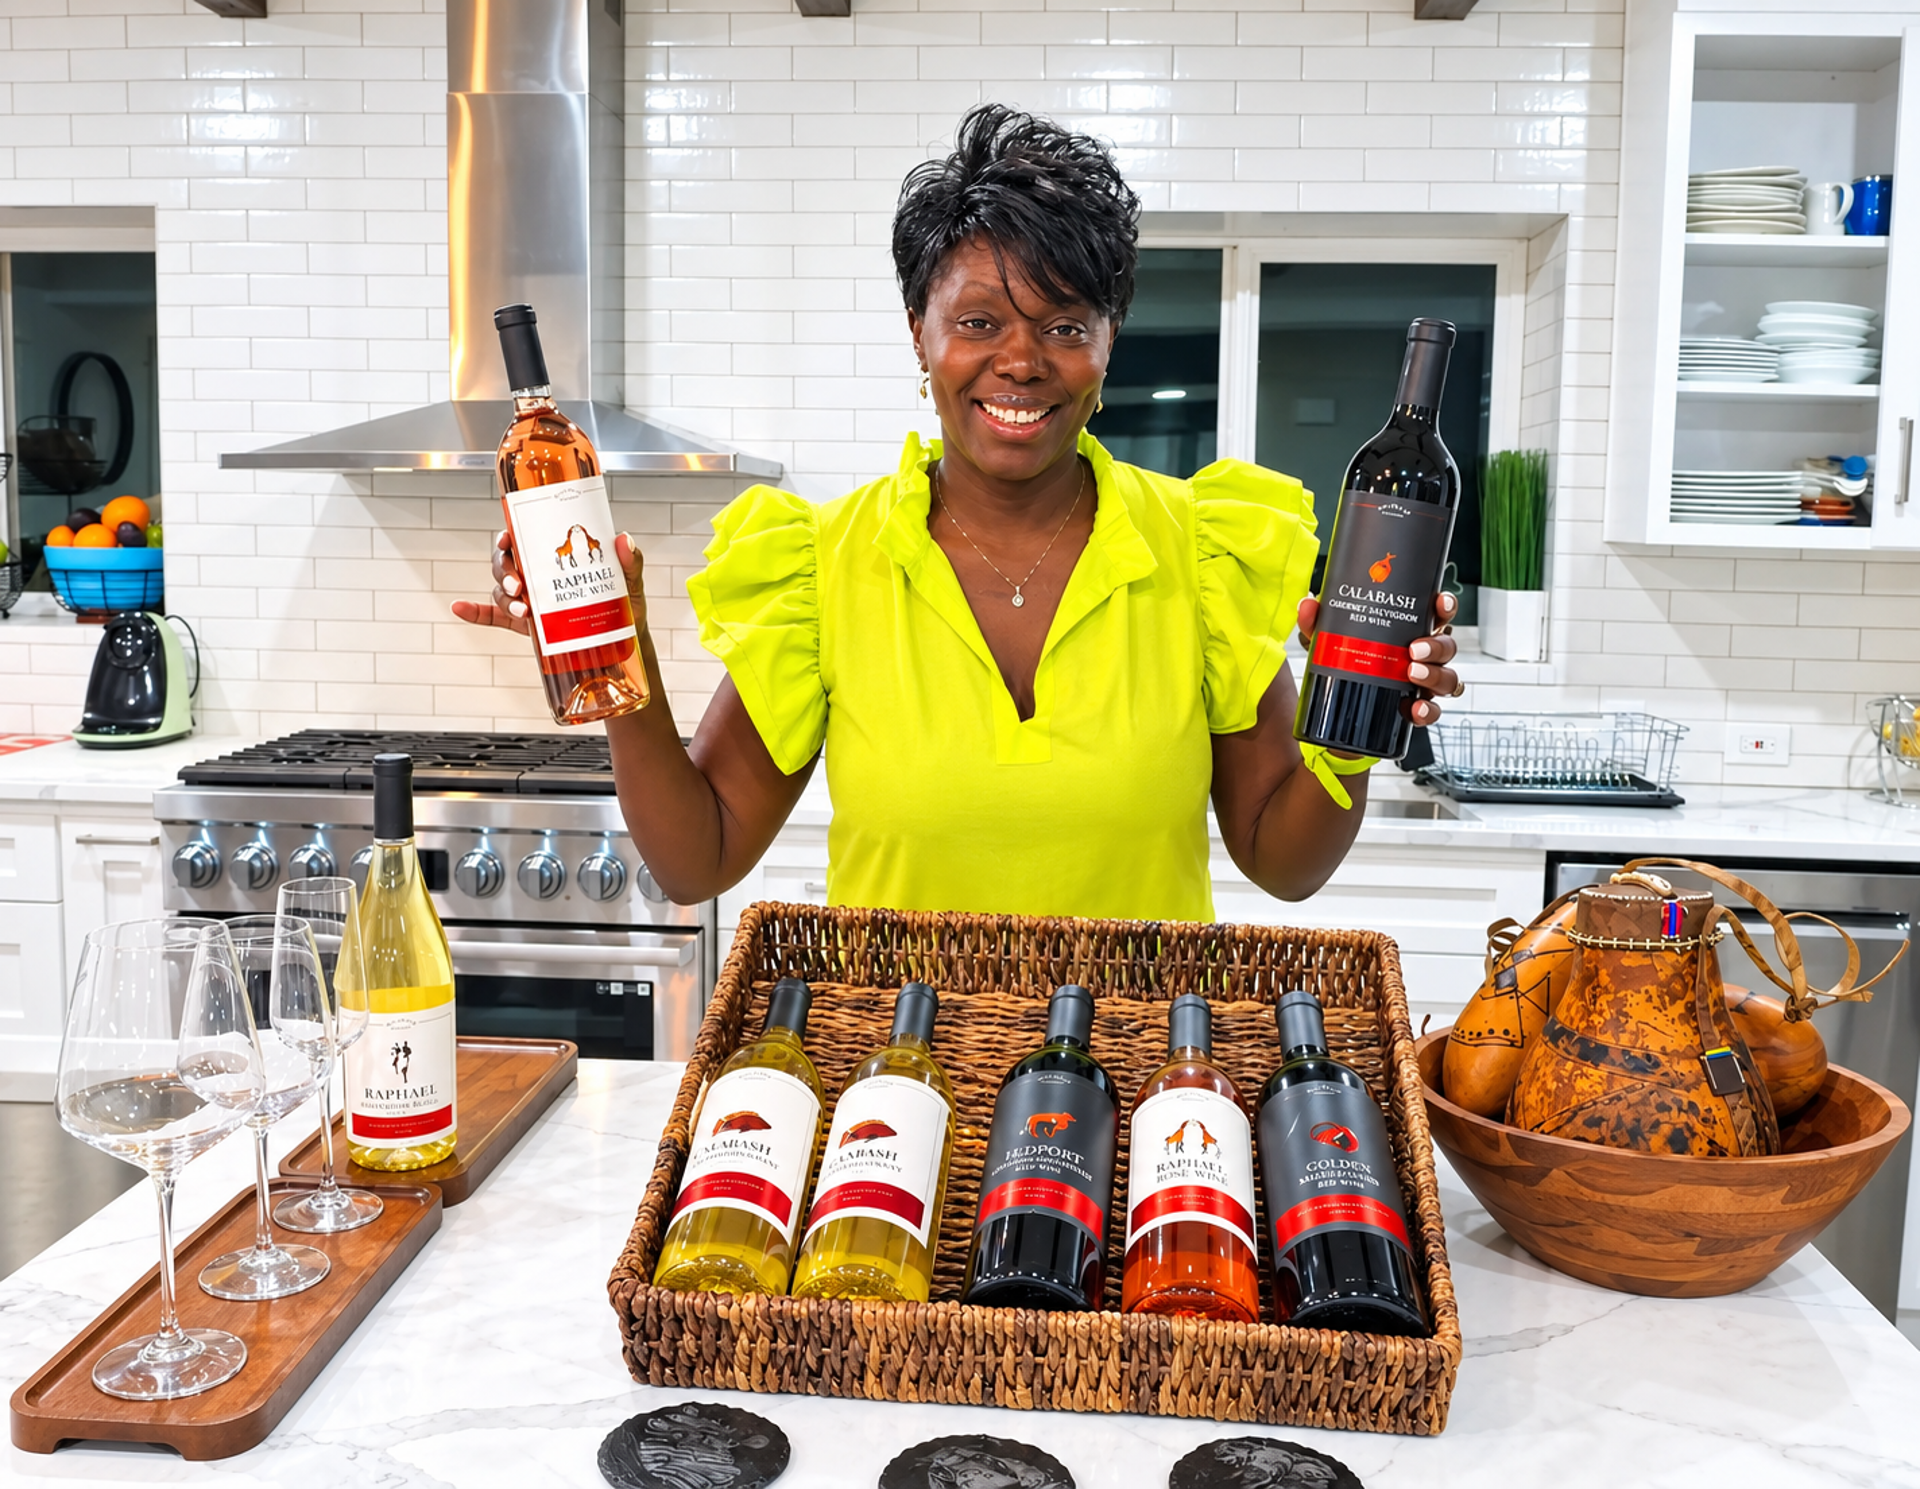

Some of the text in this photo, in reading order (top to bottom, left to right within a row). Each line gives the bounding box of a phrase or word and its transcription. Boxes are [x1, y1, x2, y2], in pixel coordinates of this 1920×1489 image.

[552, 567, 615, 590] RAPHAEL
[589, 581, 616, 596] WINE
[1338, 583, 1416, 609] CALABASH
[365, 1084, 437, 1100] RAPHAEL
[1156, 1158, 1227, 1177] RAPHAEL
